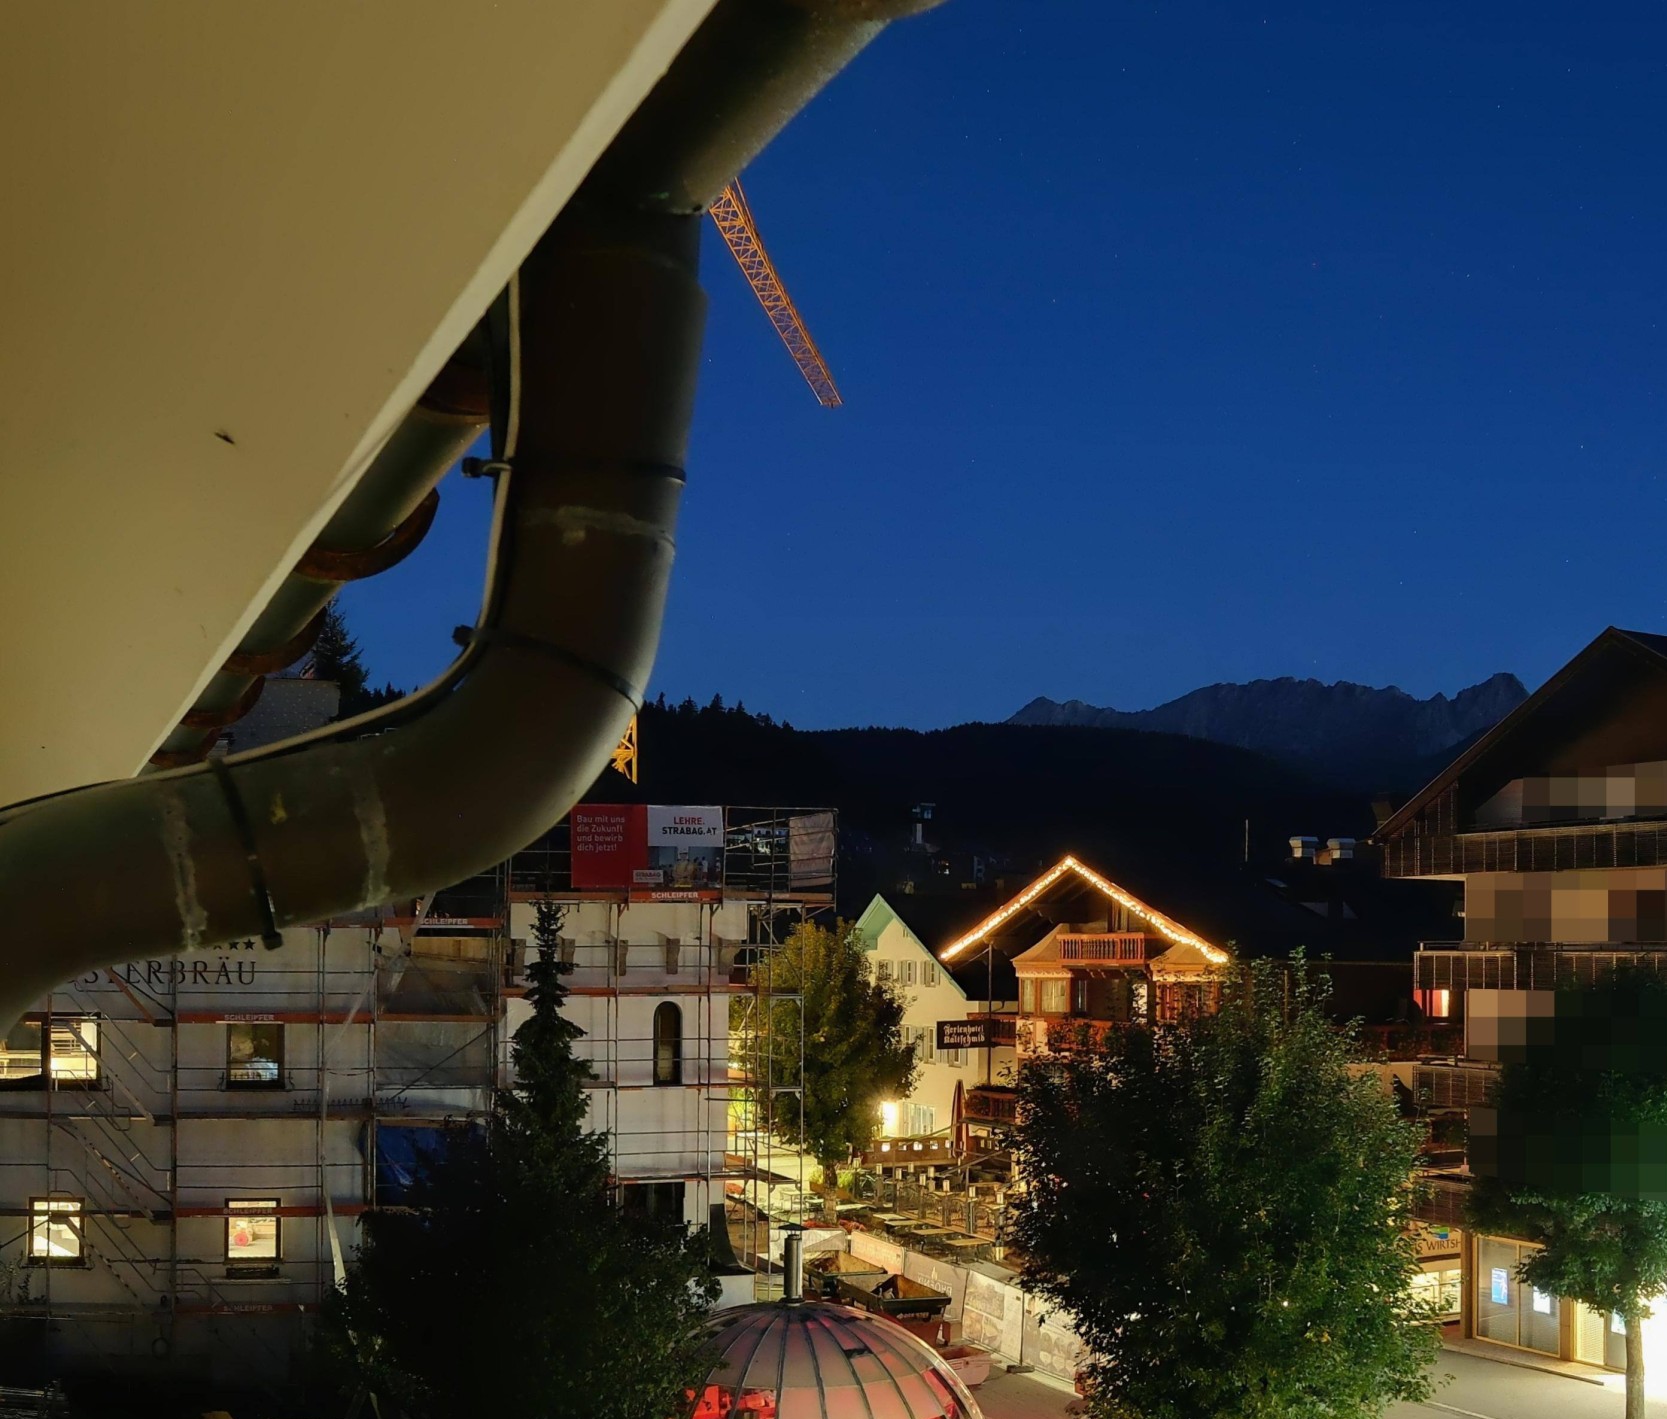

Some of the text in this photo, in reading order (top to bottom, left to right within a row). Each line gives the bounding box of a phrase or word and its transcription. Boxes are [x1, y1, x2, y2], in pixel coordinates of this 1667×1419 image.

[576, 815, 626, 824] Bau mit uns
[673, 816, 706, 826] LEHRE.
[576, 824, 624, 833] die Zukunft
[662, 826, 717, 836] STRABAG.AT
[576, 833, 624, 842] und bewirb
[576, 842, 618, 854] dich jetzt!
[651, 890, 699, 899] SCHLEIPFER
[67, 956, 257, 986] STERBRÄU
[224, 1013, 275, 1022] SCHLEIPFER
